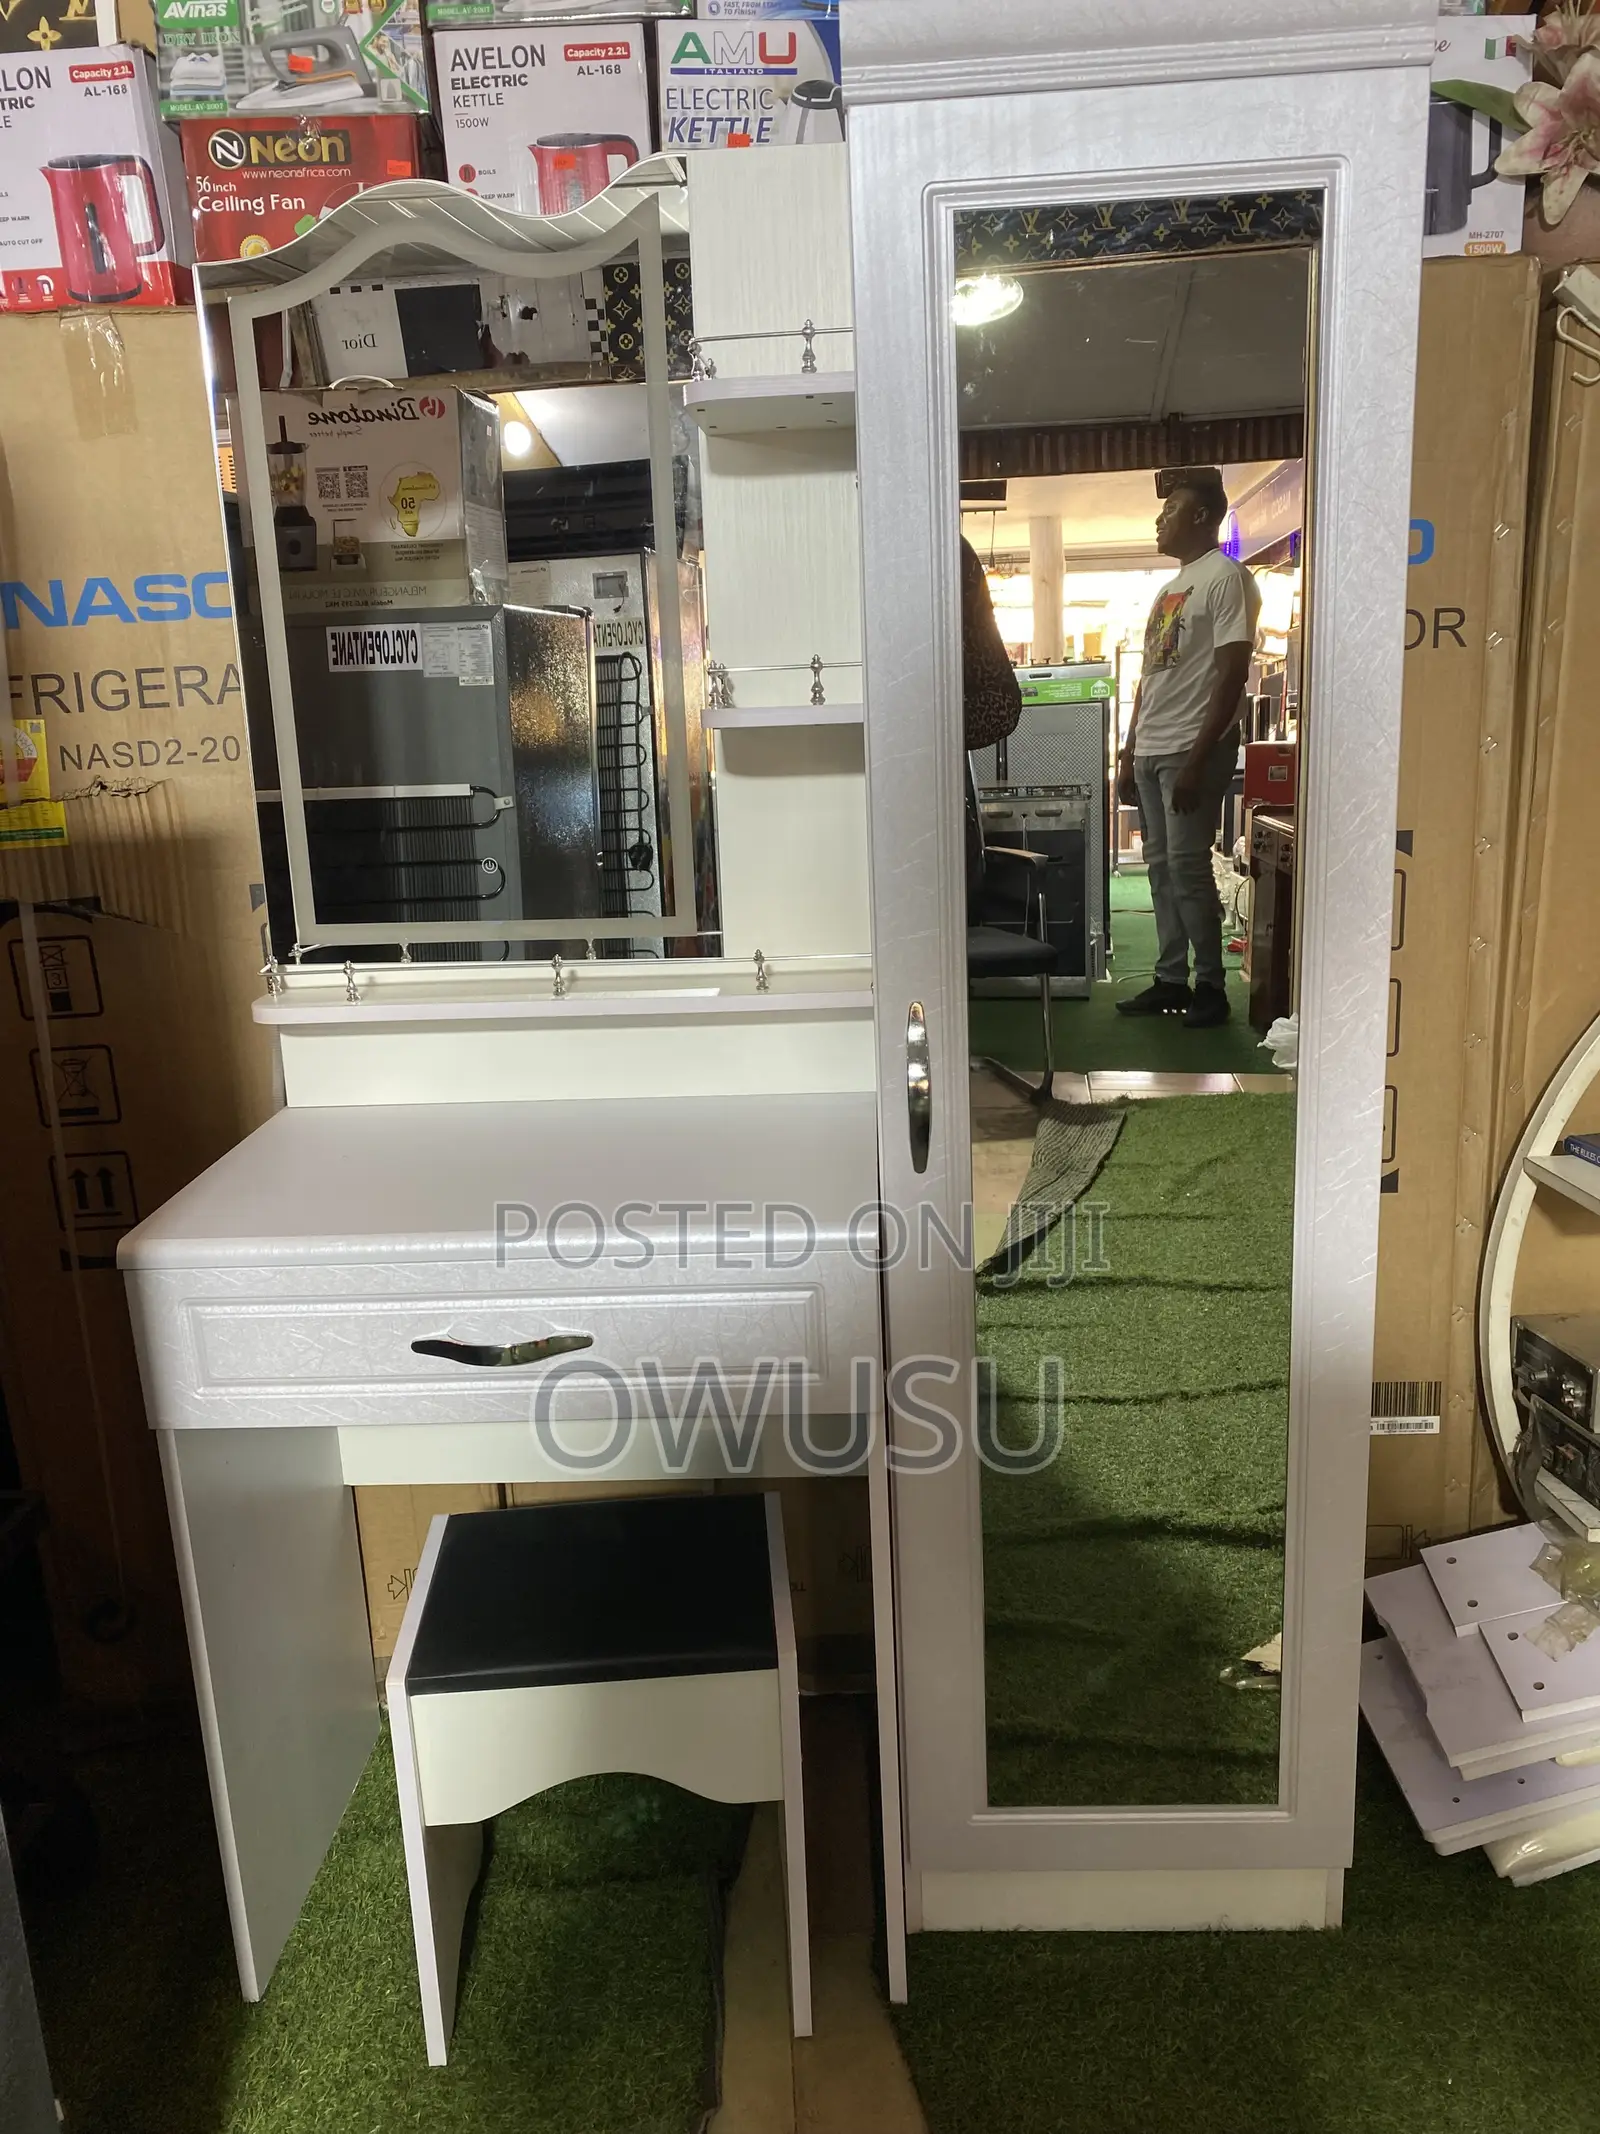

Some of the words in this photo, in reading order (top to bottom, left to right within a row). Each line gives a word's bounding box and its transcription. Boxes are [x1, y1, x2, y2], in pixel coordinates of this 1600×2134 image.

[163, 33, 196, 46] DRY
[200, 31, 242, 45] IRON
[567, 47, 606, 59] Capacity
[607, 46, 628, 56] 2.2L
[670, 31, 798, 66] AMU
[450, 44, 547, 72] AVELON
[0, 65, 52, 92] LON
[72, 68, 112, 80] Capacity
[113, 65, 132, 75] 2.2L
[576, 64, 622, 76] AL-168
[84, 84, 128, 97] AL-168
[450, 74, 529, 91] ELECTRIC
[453, 93, 505, 108] KETTLE
[666, 88, 774, 111] ELECTRIC
[455, 117, 490, 129] 1500W
[668, 116, 774, 144] KETTLE
[250, 135, 346, 164] Neon
[195, 175, 211, 193] 56
[198, 195, 264, 215] Ceiling
[271, 194, 306, 211] Fan
[1468, 230, 1505, 240] MH-2707
[1467, 243, 1503, 254] 1500W
[60, 735, 241, 772] NASD2-20
